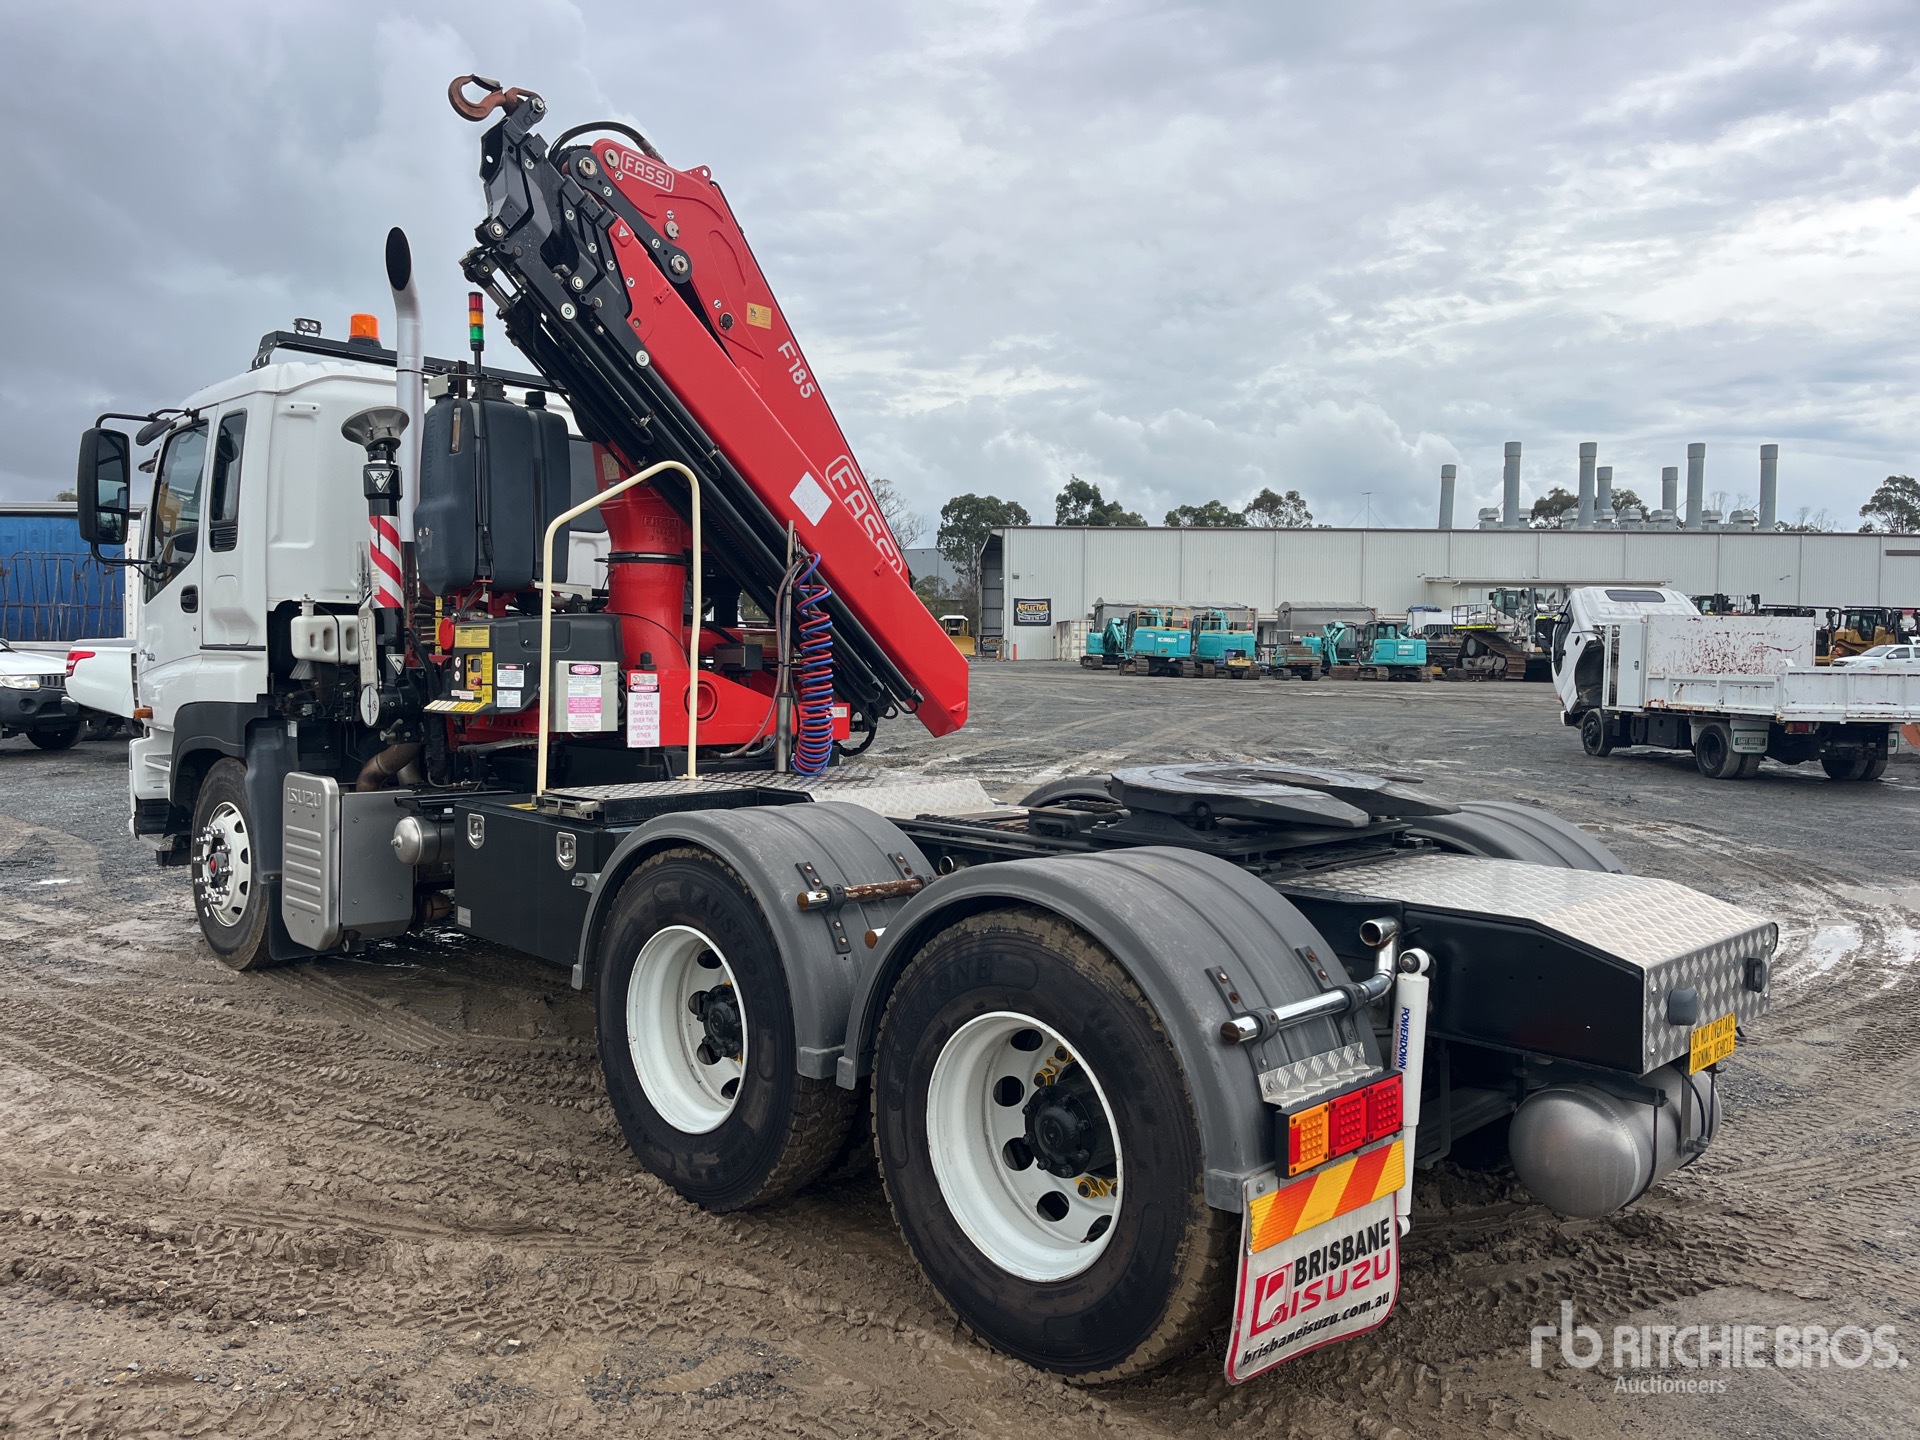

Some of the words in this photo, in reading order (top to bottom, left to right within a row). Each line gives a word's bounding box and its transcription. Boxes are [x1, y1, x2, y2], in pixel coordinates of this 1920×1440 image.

[623, 156, 671, 188] FASSI
[777, 340, 816, 399] F185
[287, 787, 322, 810] ISUZU
[1398, 1006, 1410, 1070] POWERDOWN
[1692, 1030, 1699, 1050] DO
[1700, 1024, 1710, 1045] NOT
[1711, 1013, 1734, 1041] OVERTAKE
[1692, 1045, 1712, 1071] TURNING
[1714, 1034, 1733, 1060] VEHICLE
[1294, 1217, 1391, 1287] BRISBANE
[1290, 1248, 1391, 1319] ISUZU
[1240, 1291, 1390, 1367] brisbaneisuzu.com.au
